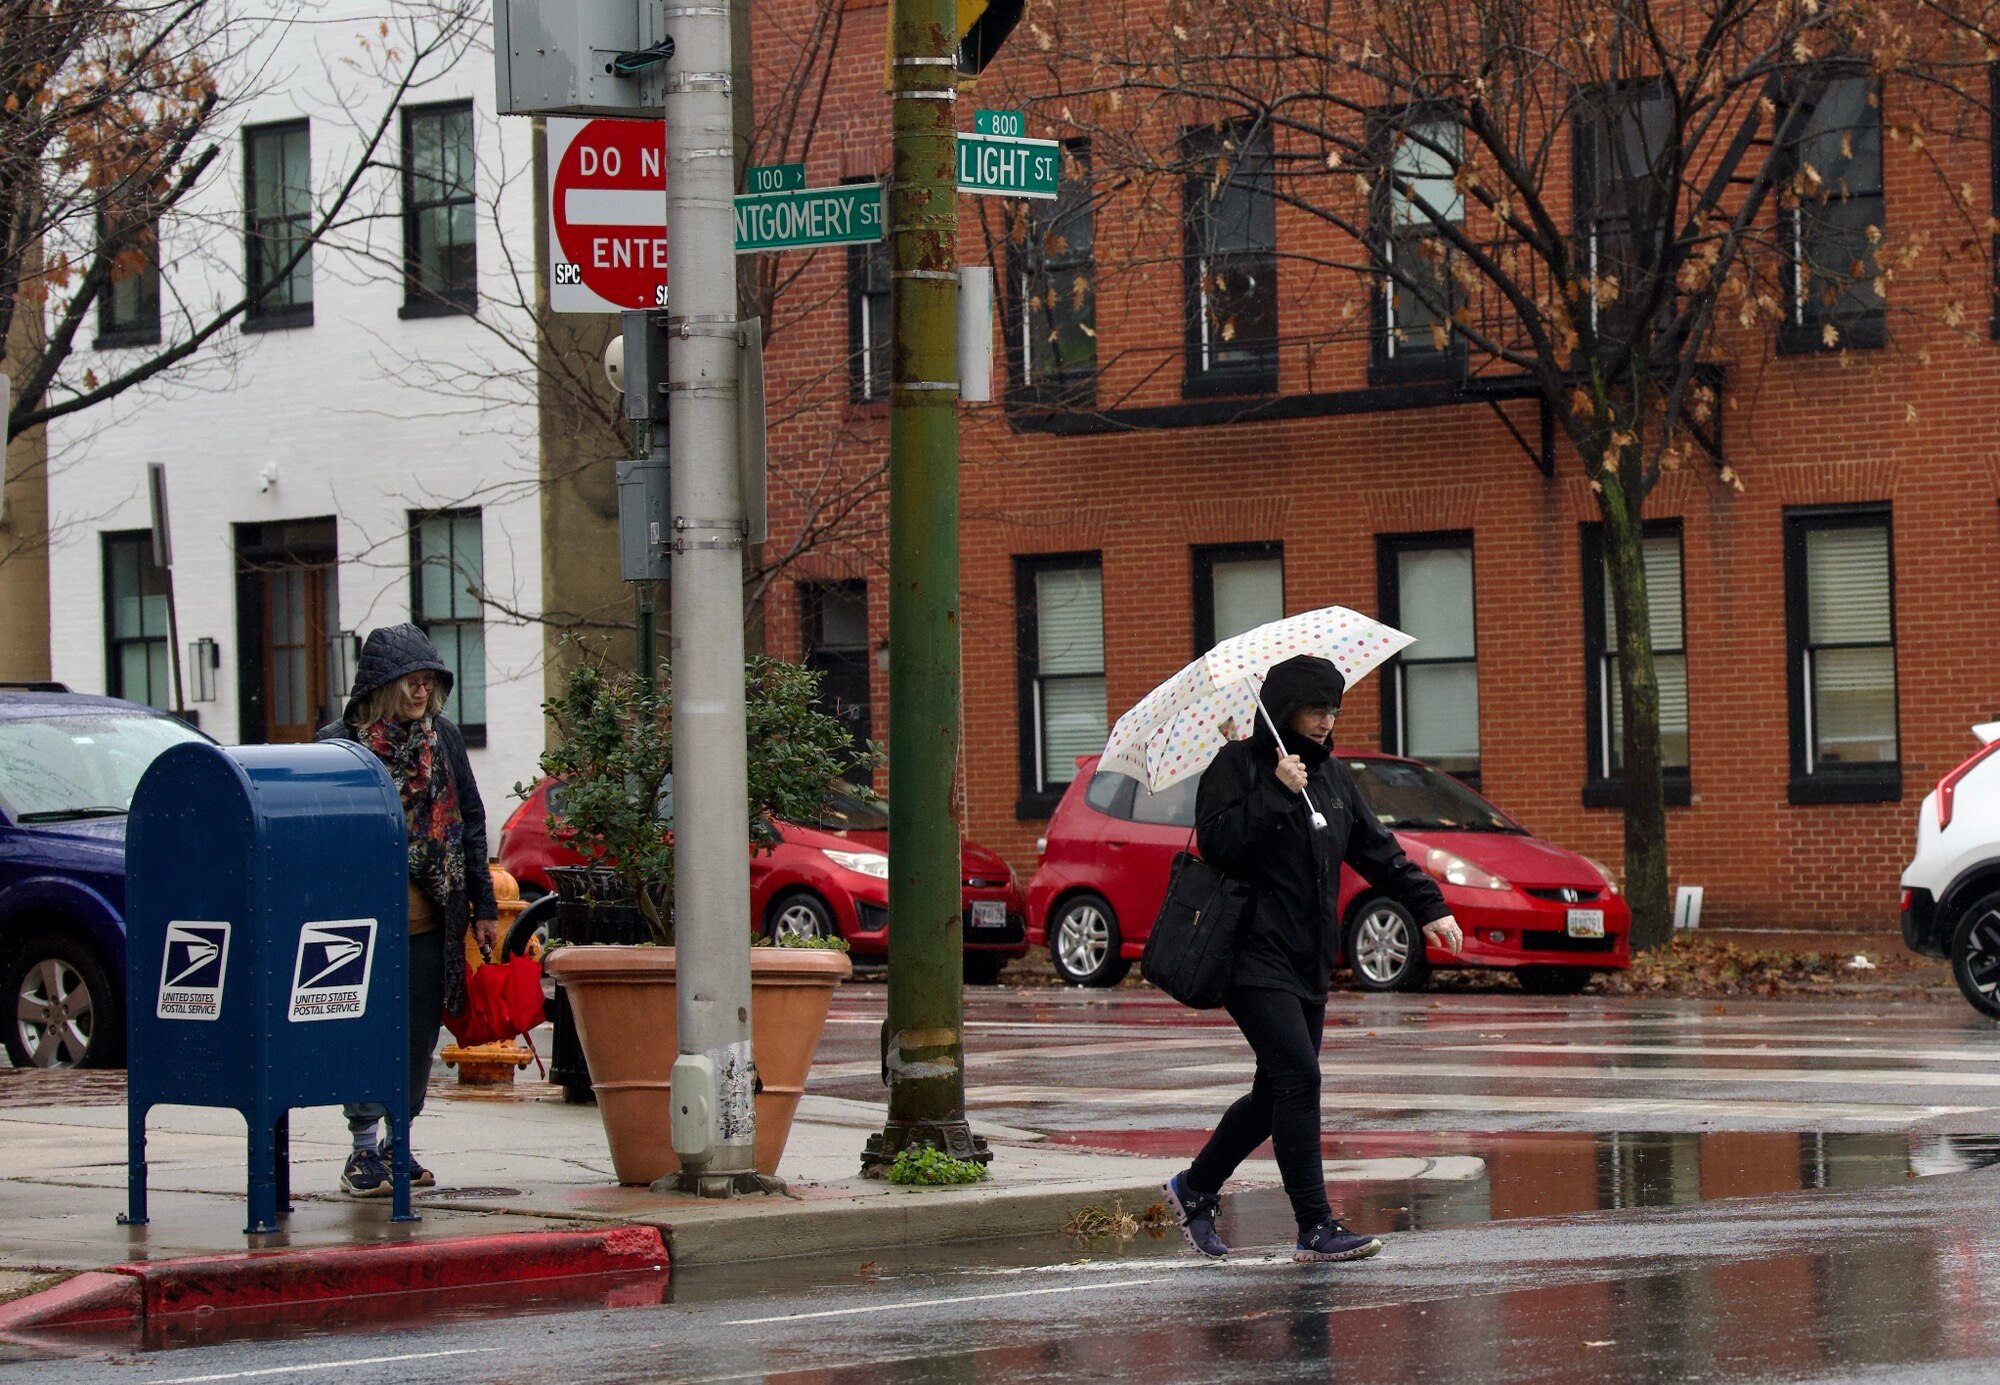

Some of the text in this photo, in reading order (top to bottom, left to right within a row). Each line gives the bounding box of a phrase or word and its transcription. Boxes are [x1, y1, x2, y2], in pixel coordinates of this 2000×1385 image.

[992, 114, 1018, 135] 800
[579, 146, 667, 177] DO N
[961, 145, 1053, 187] LIGHT ST.
[757, 169, 783, 190] 100
[735, 197, 855, 242] NTGOMERY
[593, 238, 668, 268] ENTE
[556, 264, 581, 283] SPC
[162, 993, 214, 1002] UNITED STATES
[295, 991, 358, 1004] UNITED STATES
[161, 1004, 216, 1014] POSTAL SERVICE
[293, 1003, 360, 1016] POSTAL SERVICE
